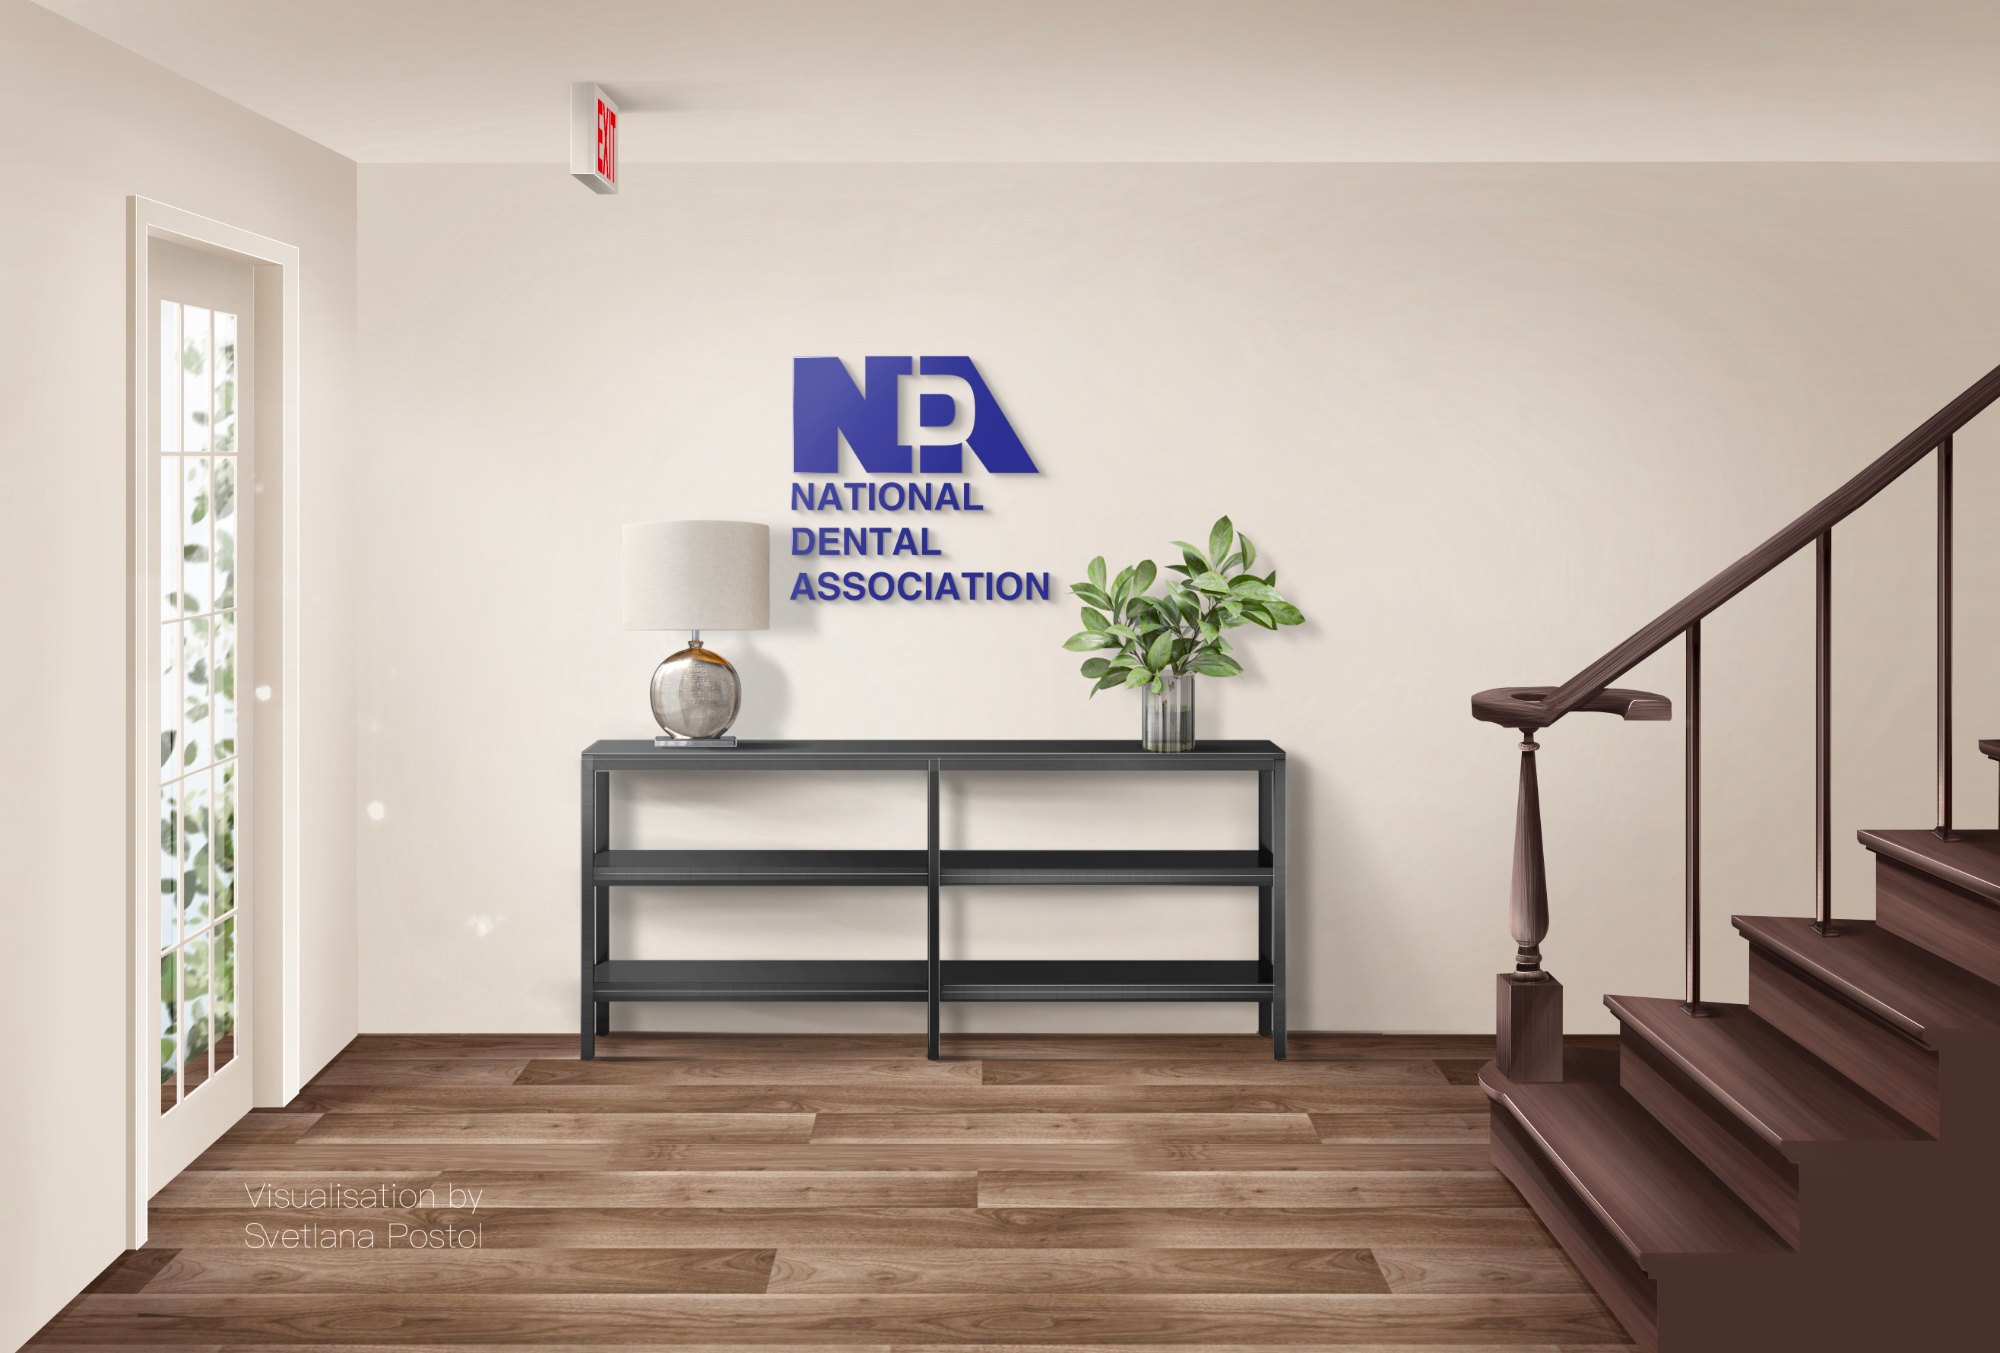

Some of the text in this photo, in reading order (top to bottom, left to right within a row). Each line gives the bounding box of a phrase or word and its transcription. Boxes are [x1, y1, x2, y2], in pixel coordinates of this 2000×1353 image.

[597, 97, 616, 183] EXIT
[793, 356, 1039, 473] NDA
[791, 482, 984, 511] NATIONAL
[791, 527, 942, 556] DENTAL
[790, 572, 1049, 601] ASSOCIATION
